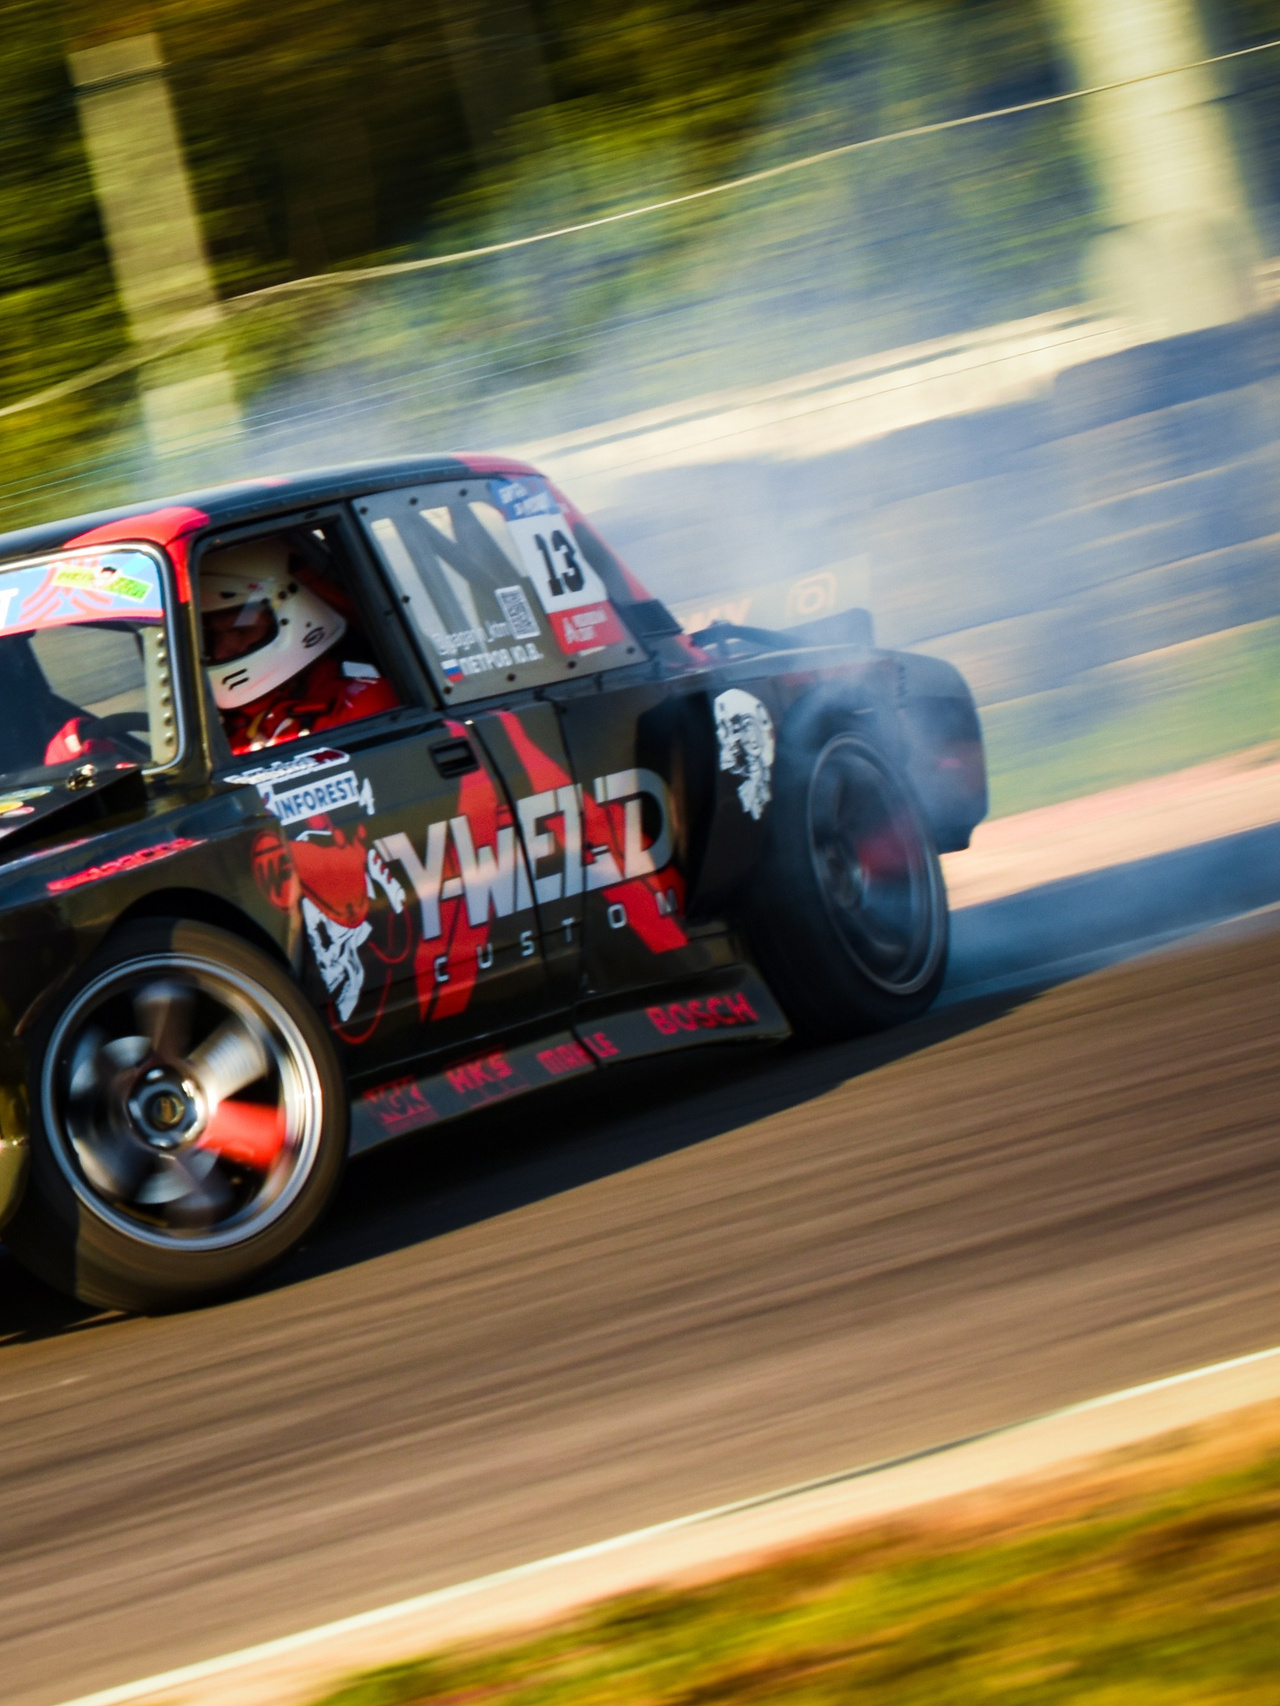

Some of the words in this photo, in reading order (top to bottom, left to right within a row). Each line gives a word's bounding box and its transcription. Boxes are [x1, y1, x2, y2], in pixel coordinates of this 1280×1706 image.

[533, 529, 586, 597] 13
[274, 776, 357, 822] INFOREST
[433, 888, 680, 984] CUSTOM
[645, 992, 760, 1036] BOSCH
[444, 1048, 514, 1095] HKS
